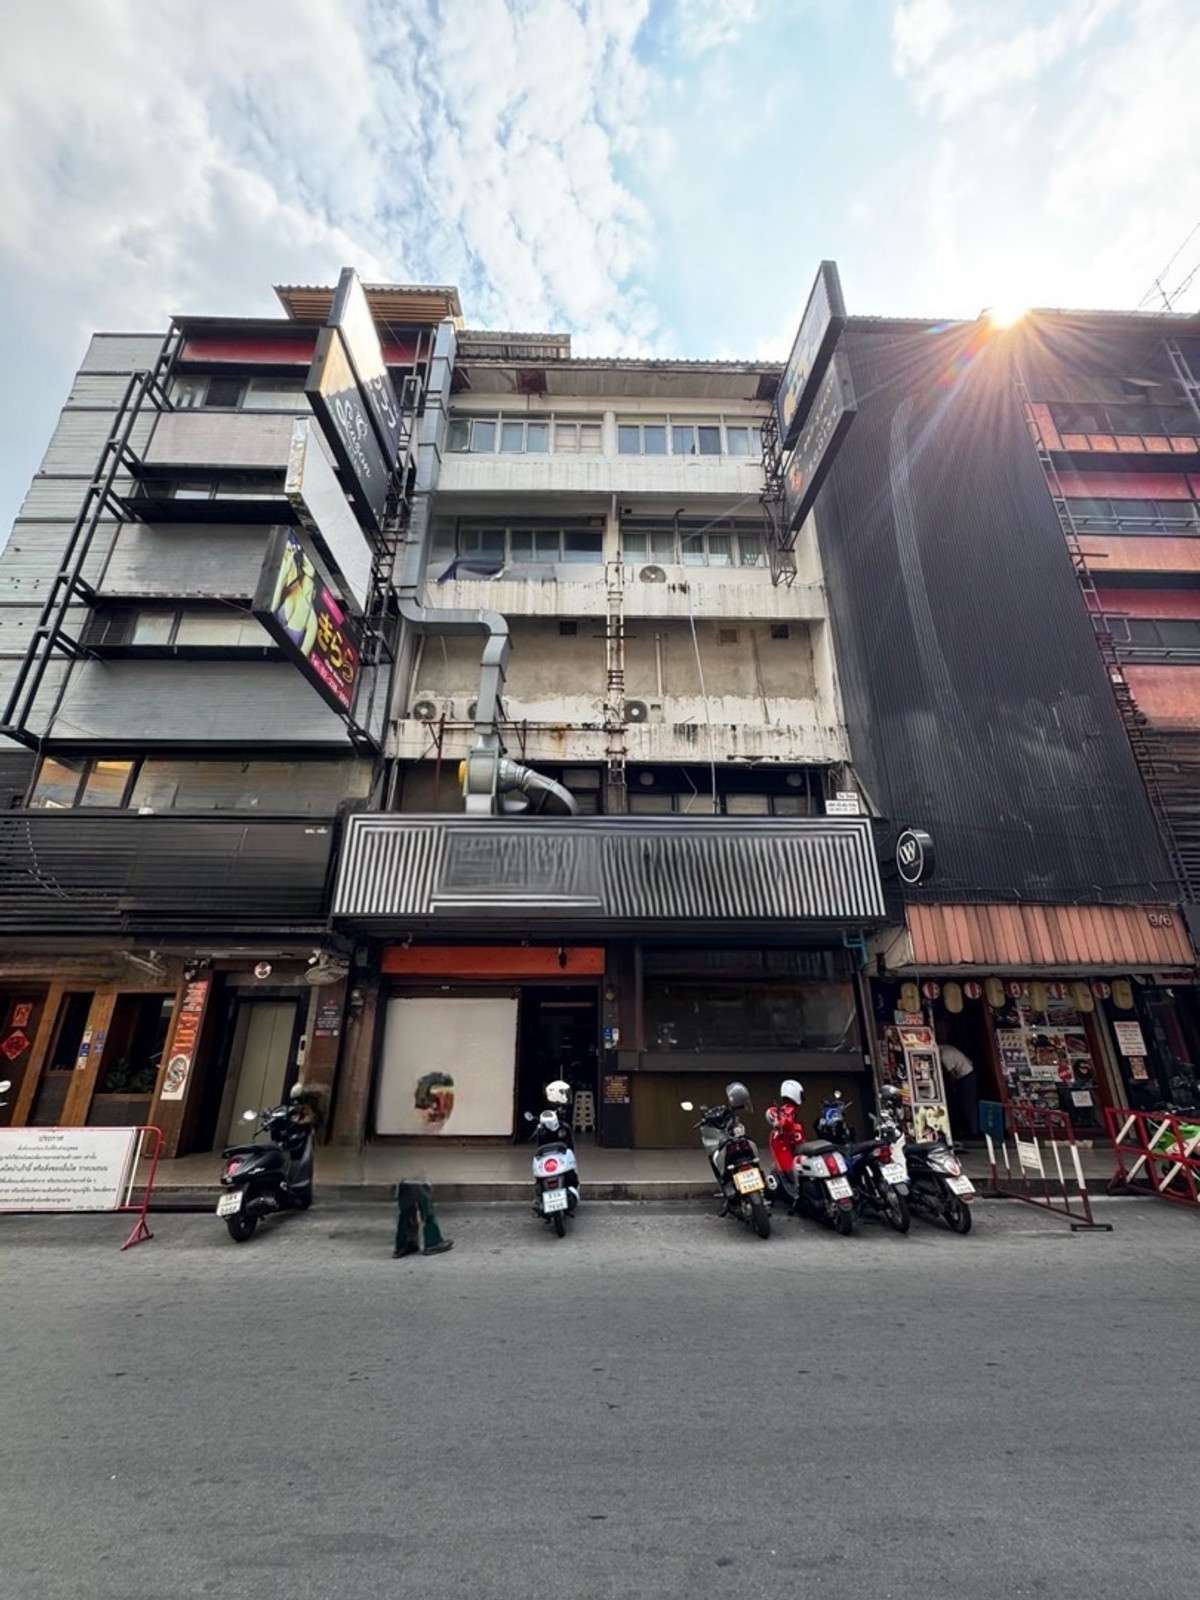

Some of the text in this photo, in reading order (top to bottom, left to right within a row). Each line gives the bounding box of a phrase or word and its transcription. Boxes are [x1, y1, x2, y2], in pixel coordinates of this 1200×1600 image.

[316, 612, 354, 684] きらら
[1149, 913, 1172, 926] 9/6
